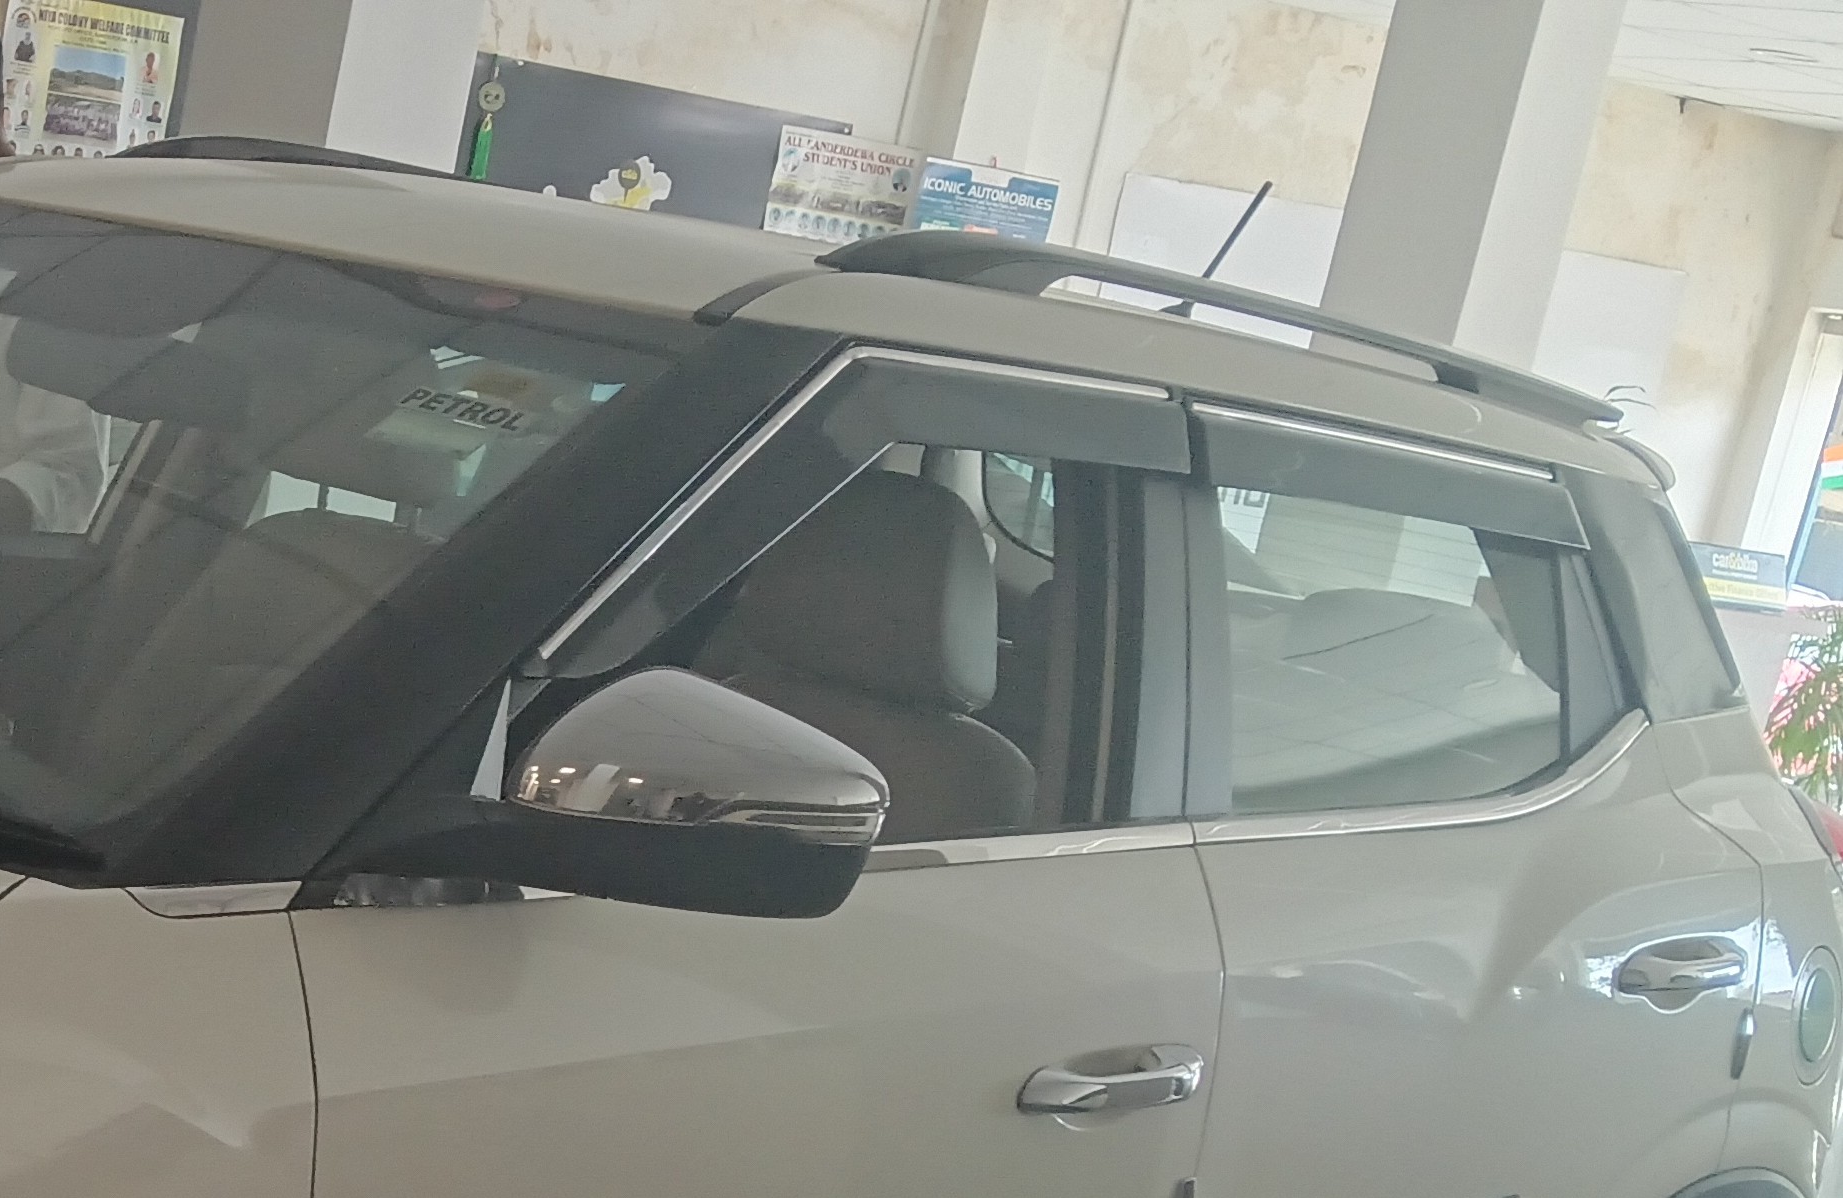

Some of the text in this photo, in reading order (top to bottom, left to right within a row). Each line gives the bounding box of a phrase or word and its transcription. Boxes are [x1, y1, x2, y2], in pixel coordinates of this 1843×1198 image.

[90, 17, 124, 36] WELFARE
[125, 23, 171, 44] COMMITTEE
[785, 135, 803, 148] ALL
[878, 152, 915, 169] CIRCLE
[803, 152, 893, 177] STUDENT'S UNION
[923, 176, 966, 196] ICONIC
[967, 185, 1054, 212] AUTOMOBILES
[400, 387, 525, 432] PETROL
